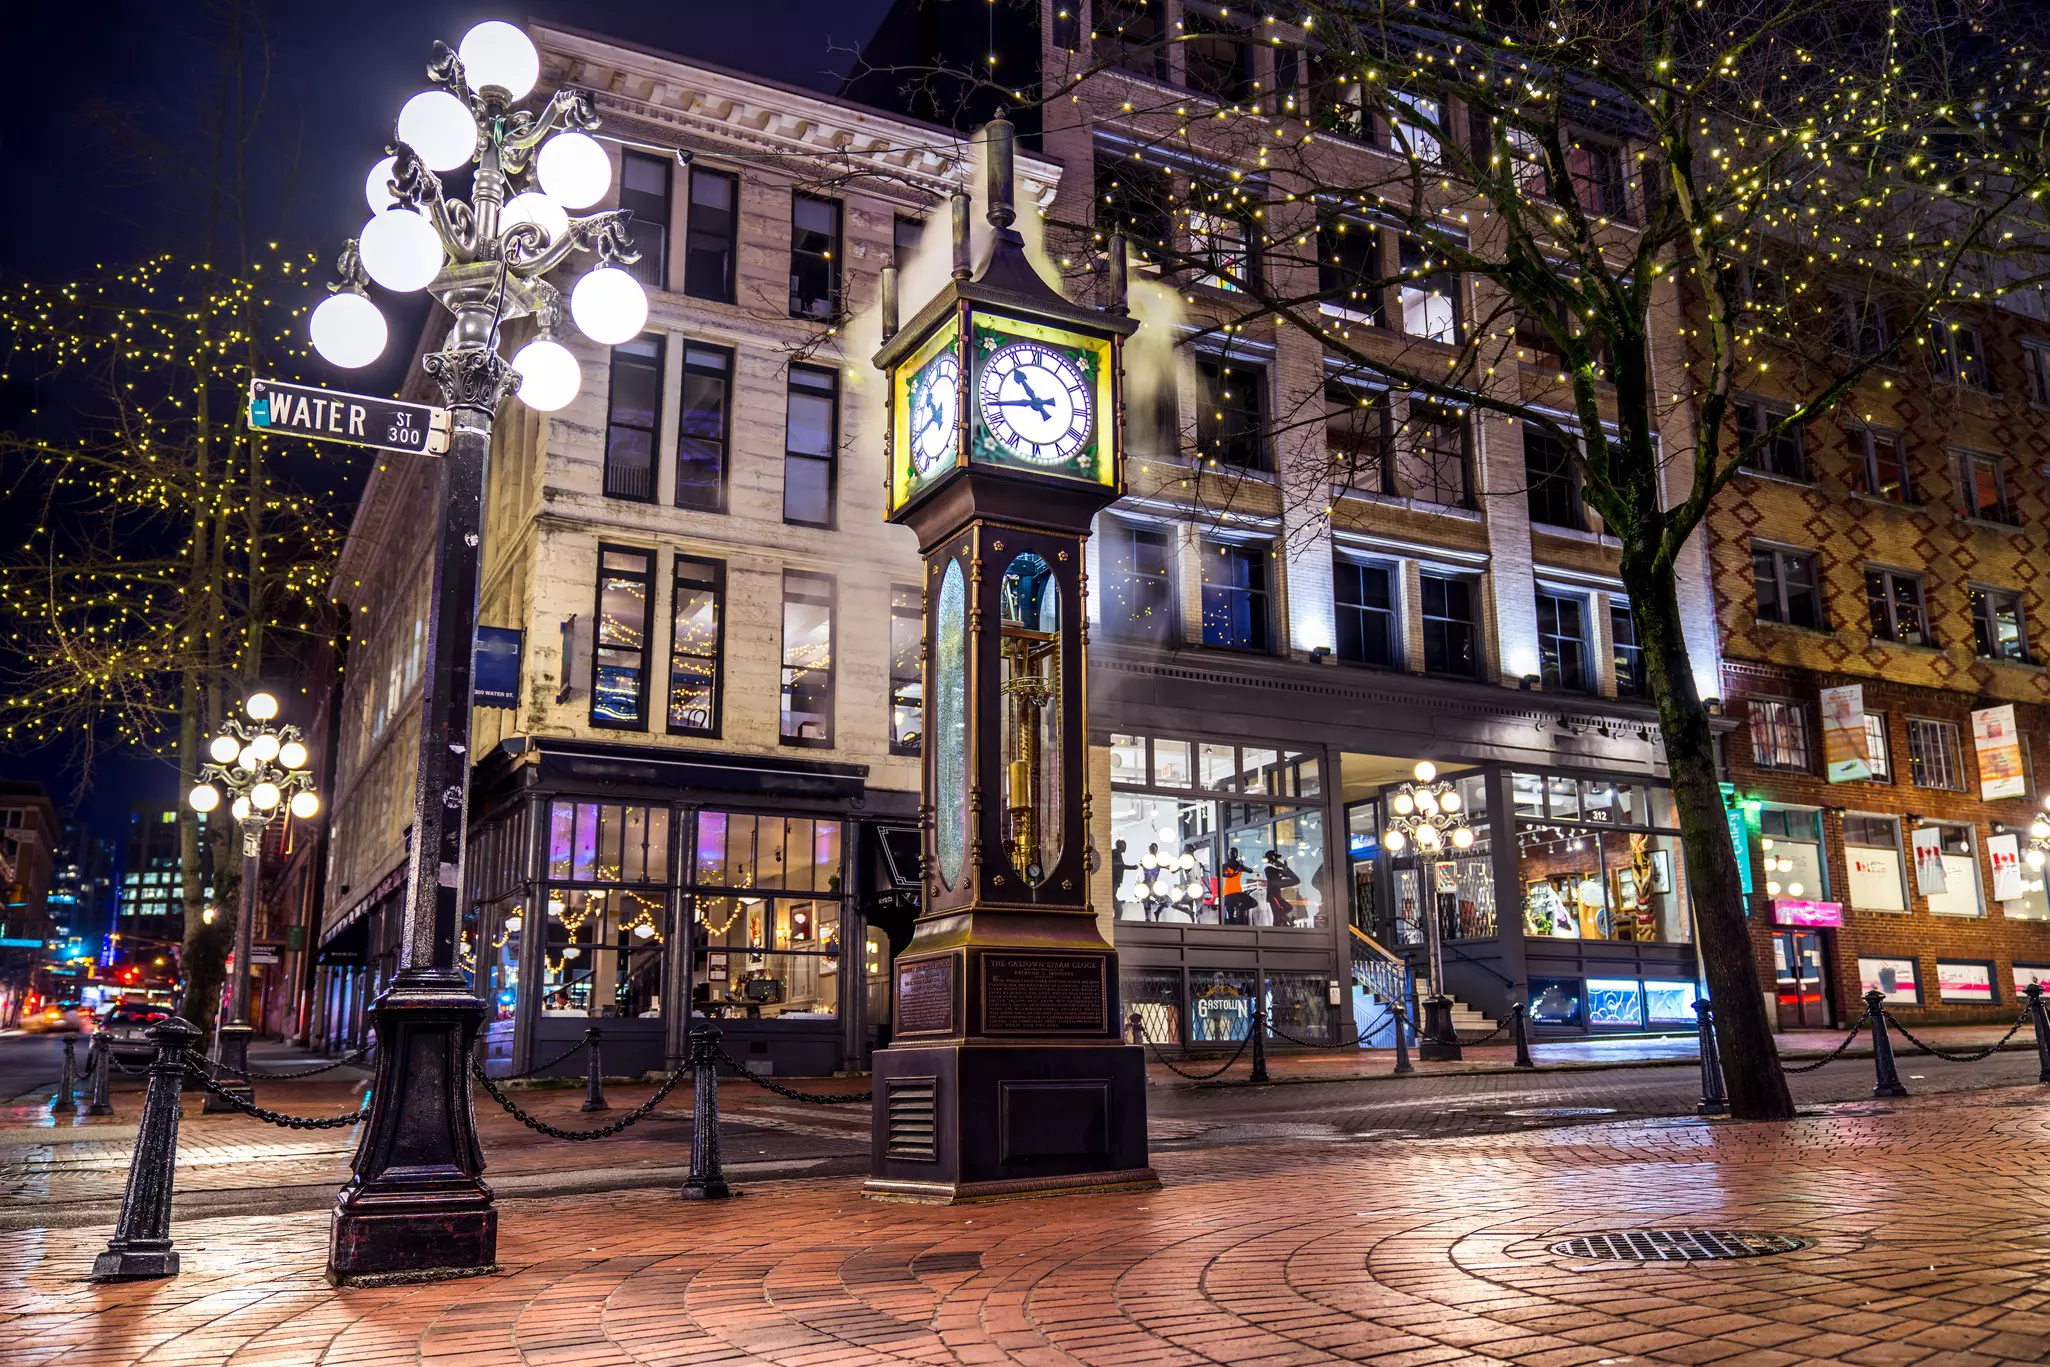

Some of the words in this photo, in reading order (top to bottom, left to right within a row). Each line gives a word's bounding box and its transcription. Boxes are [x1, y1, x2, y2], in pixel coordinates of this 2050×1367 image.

[269, 391, 366, 437] WATER
[397, 412, 413, 428] ST
[389, 427, 420, 444] 300
[1592, 810, 1607, 821] 312
[1007, 960, 1045, 968] GASTOWN
[1046, 961, 1070, 969] STEAM
[1072, 961, 1097, 969] CLOCK
[1198, 999, 1248, 1017] GASTOWN
